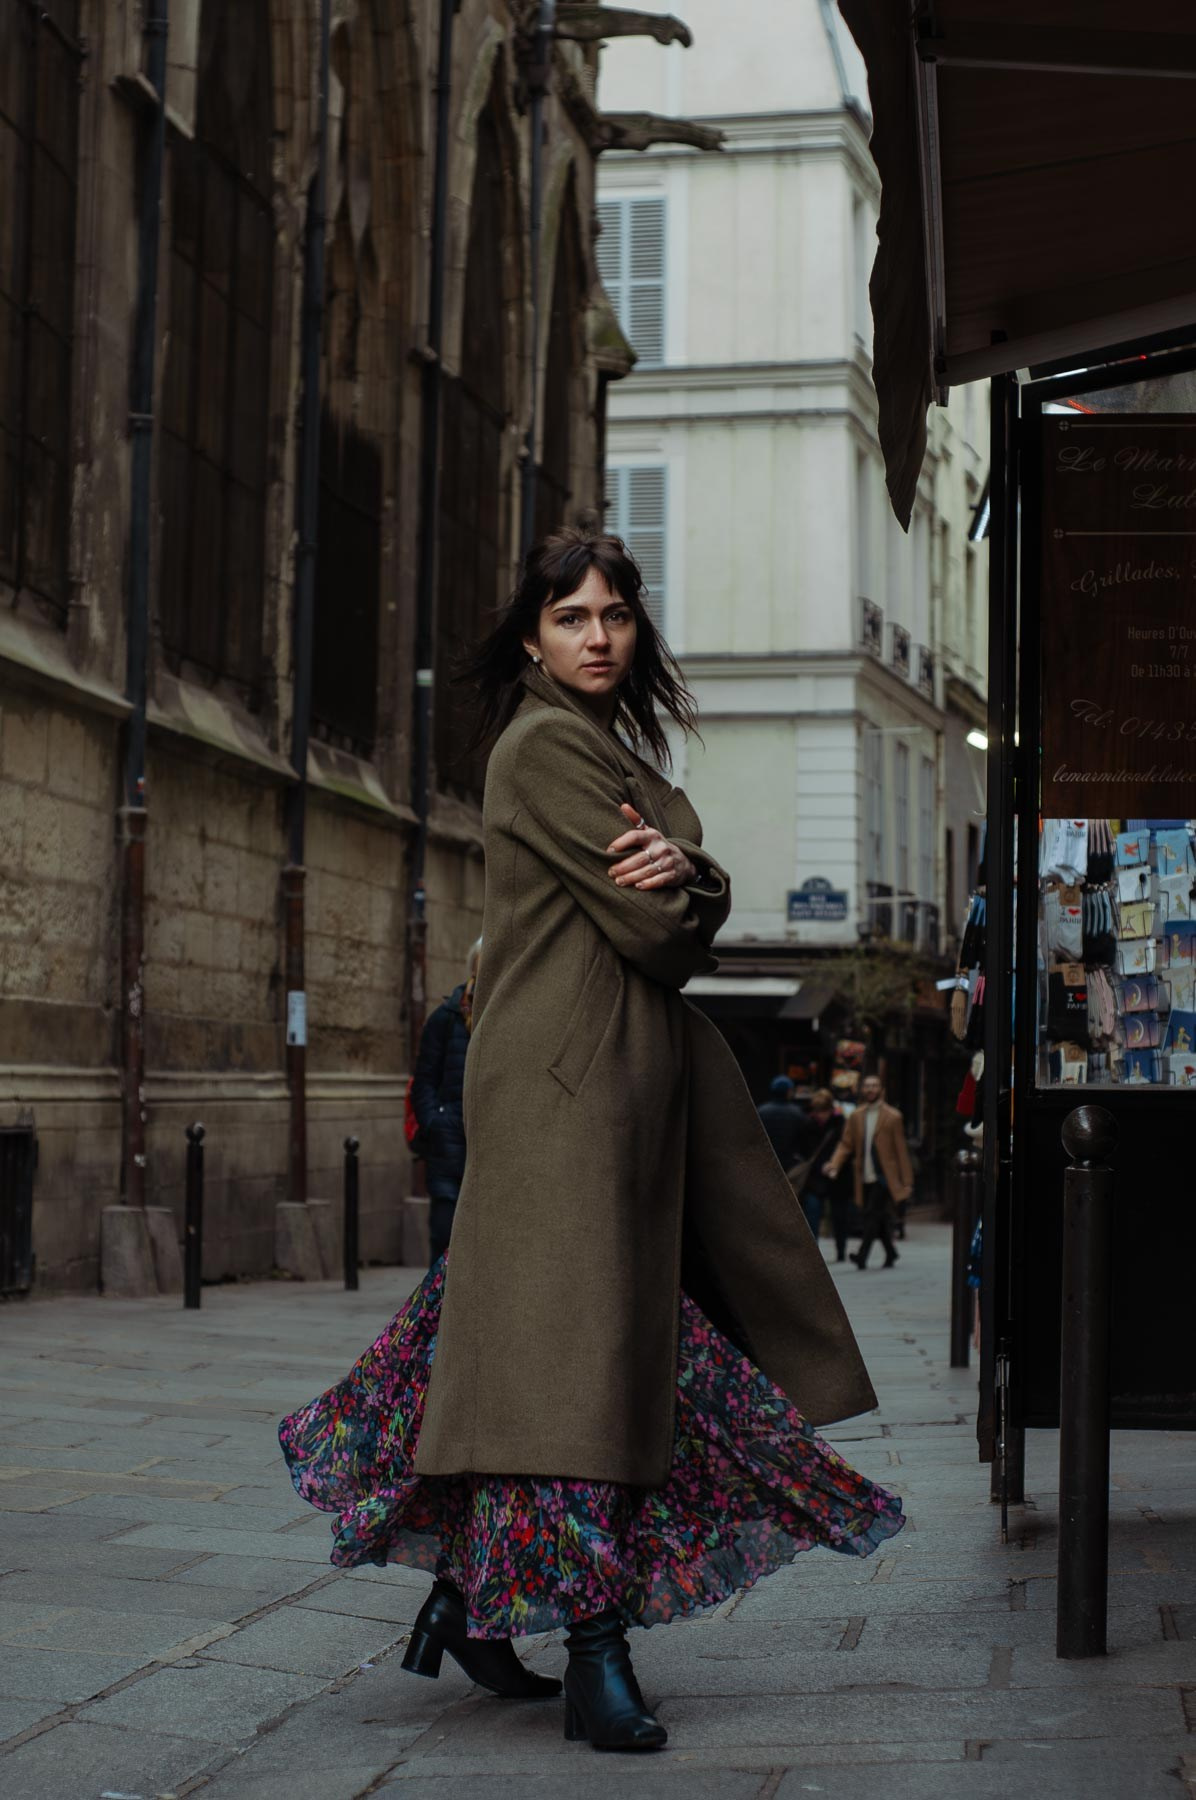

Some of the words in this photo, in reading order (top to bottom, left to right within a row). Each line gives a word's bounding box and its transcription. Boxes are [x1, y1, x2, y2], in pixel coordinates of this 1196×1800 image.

[1056, 446, 1106, 472] Le
[1128, 626, 1165, 640] Heures
[1168, 644, 1189, 660] 7/7
[1131, 664, 1145, 678] De
[1149, 664, 1181, 678] 11h30
[1183, 664, 1191, 678] à
